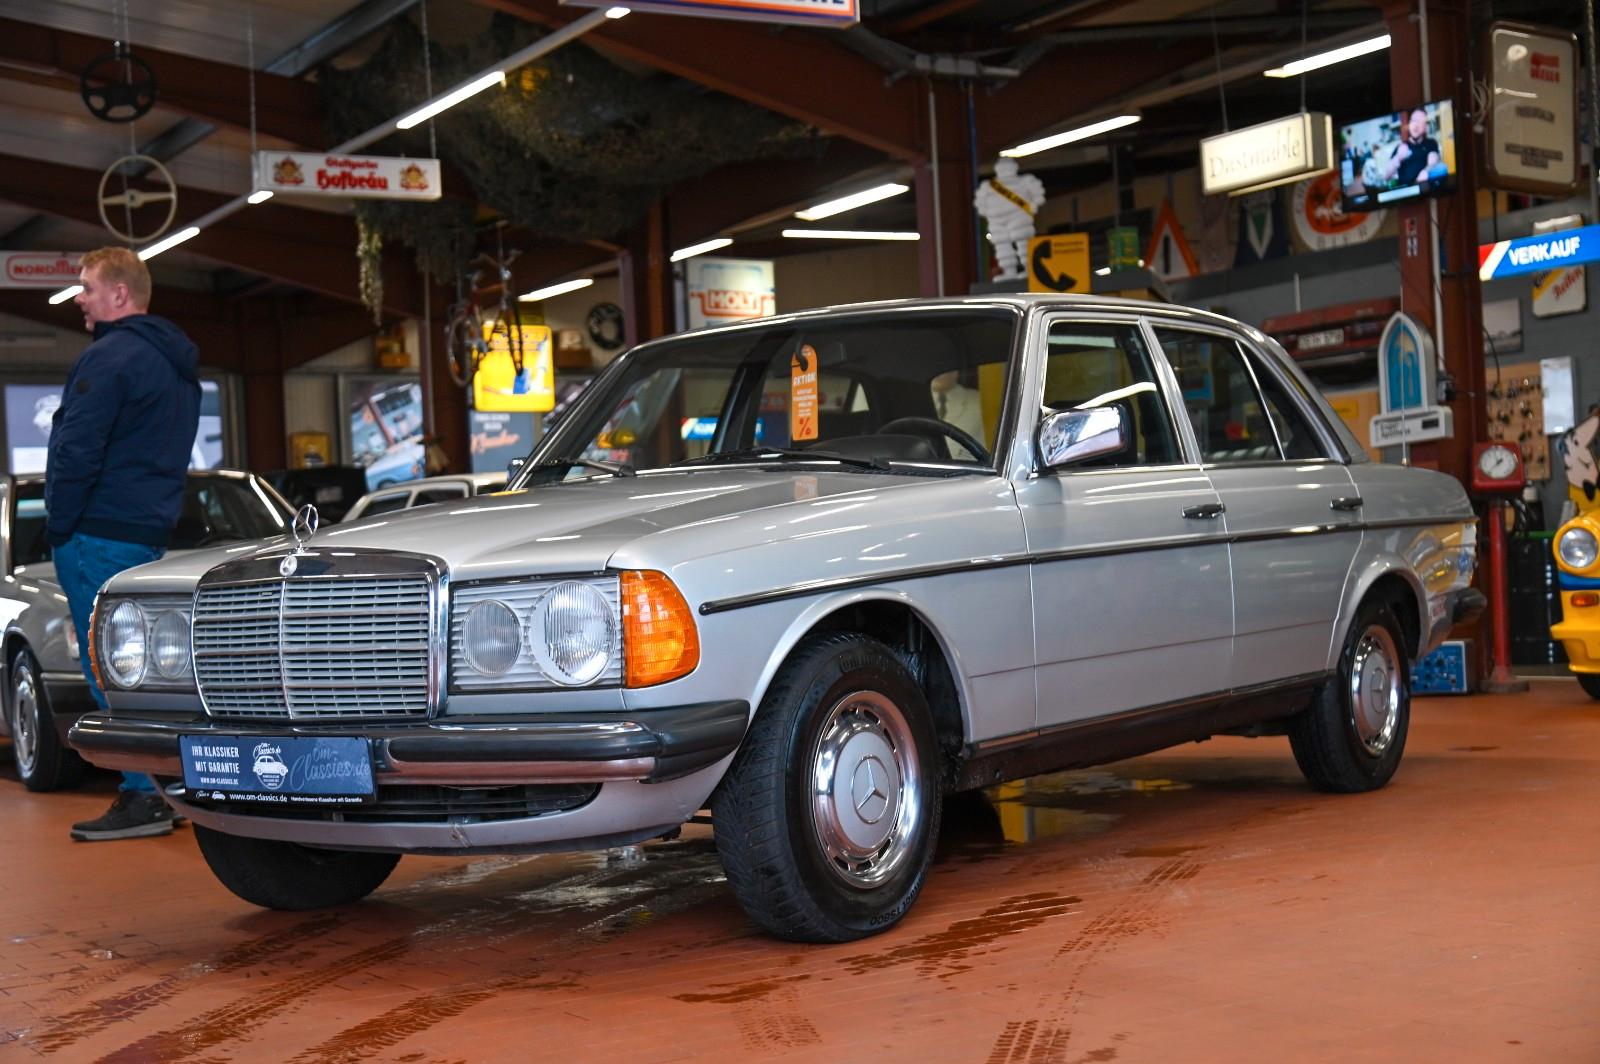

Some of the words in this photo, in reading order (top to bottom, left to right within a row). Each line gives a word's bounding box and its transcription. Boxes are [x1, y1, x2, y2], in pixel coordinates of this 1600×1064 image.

[1508, 236, 1580, 266] VERKAUF
[192, 745, 203, 757] IHR
[204, 746, 240, 758] KLASSIKER
[195, 761, 207, 772] MIT
[208, 762, 240, 774] GARANTIE
[290, 754, 371, 791] Classics.de
[229, 793, 288, 803] www.om-classics.de
